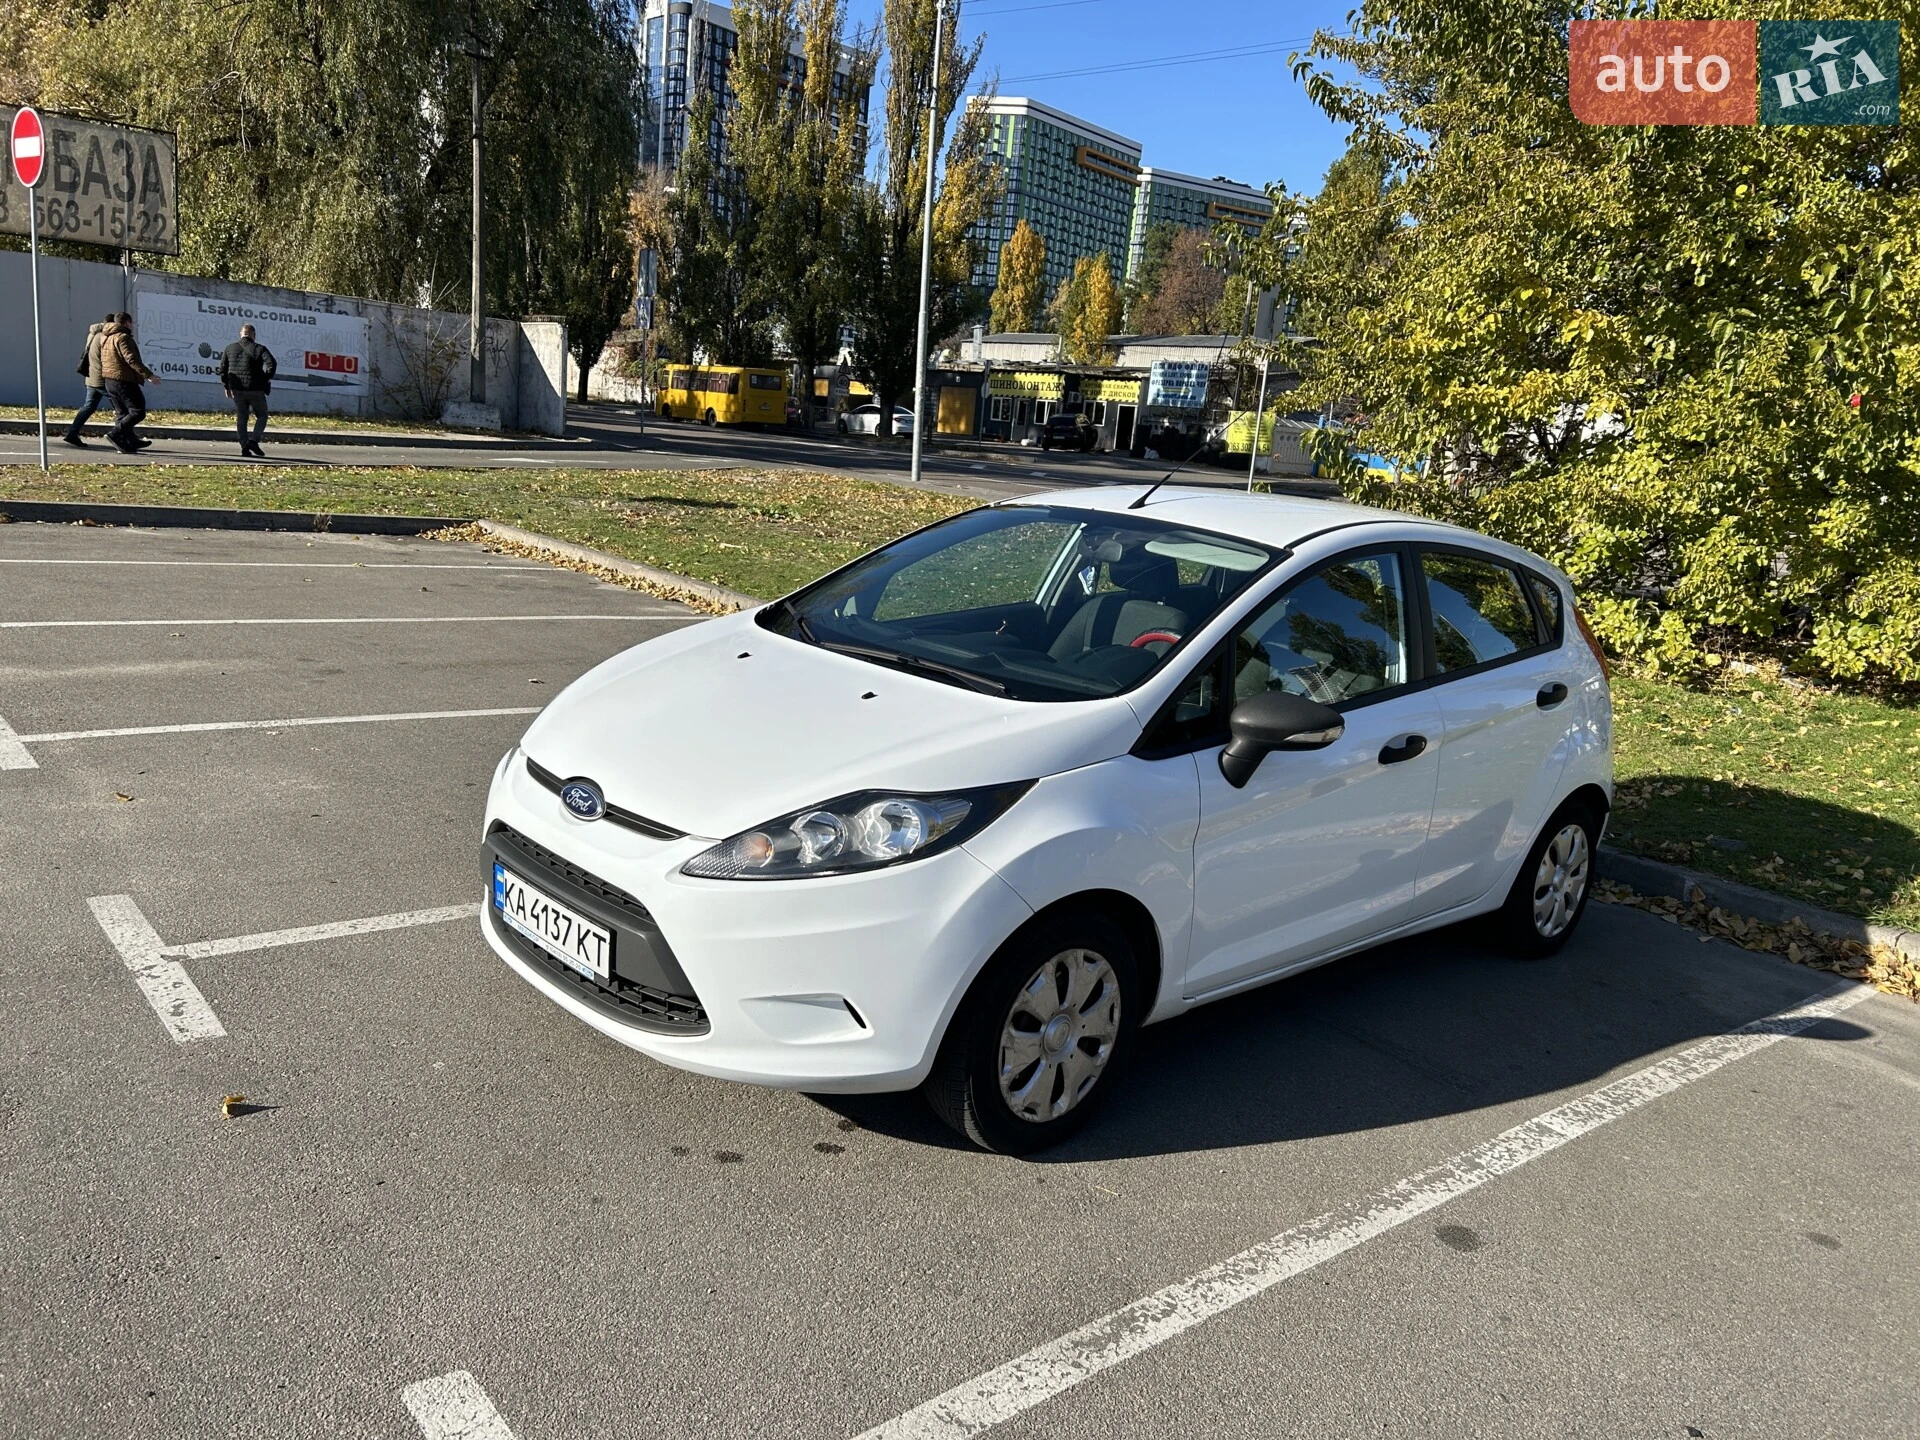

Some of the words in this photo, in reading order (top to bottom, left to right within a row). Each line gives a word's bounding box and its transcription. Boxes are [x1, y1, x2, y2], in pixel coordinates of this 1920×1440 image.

[198, 300, 317, 326] Lsavto.com.ua
[161, 362, 189, 376] (044)
[308, 352, 355, 373] СТО
[838, 378, 848, 387] 40
[990, 379, 1062, 392] ШИНОМОНТАЖ
[1108, 390, 1136, 398] ДИСКОВ
[566, 788, 593, 812] Ford
[504, 878, 527, 921] KA
[530, 898, 573, 947] 4137
[577, 922, 607, 968] KT
